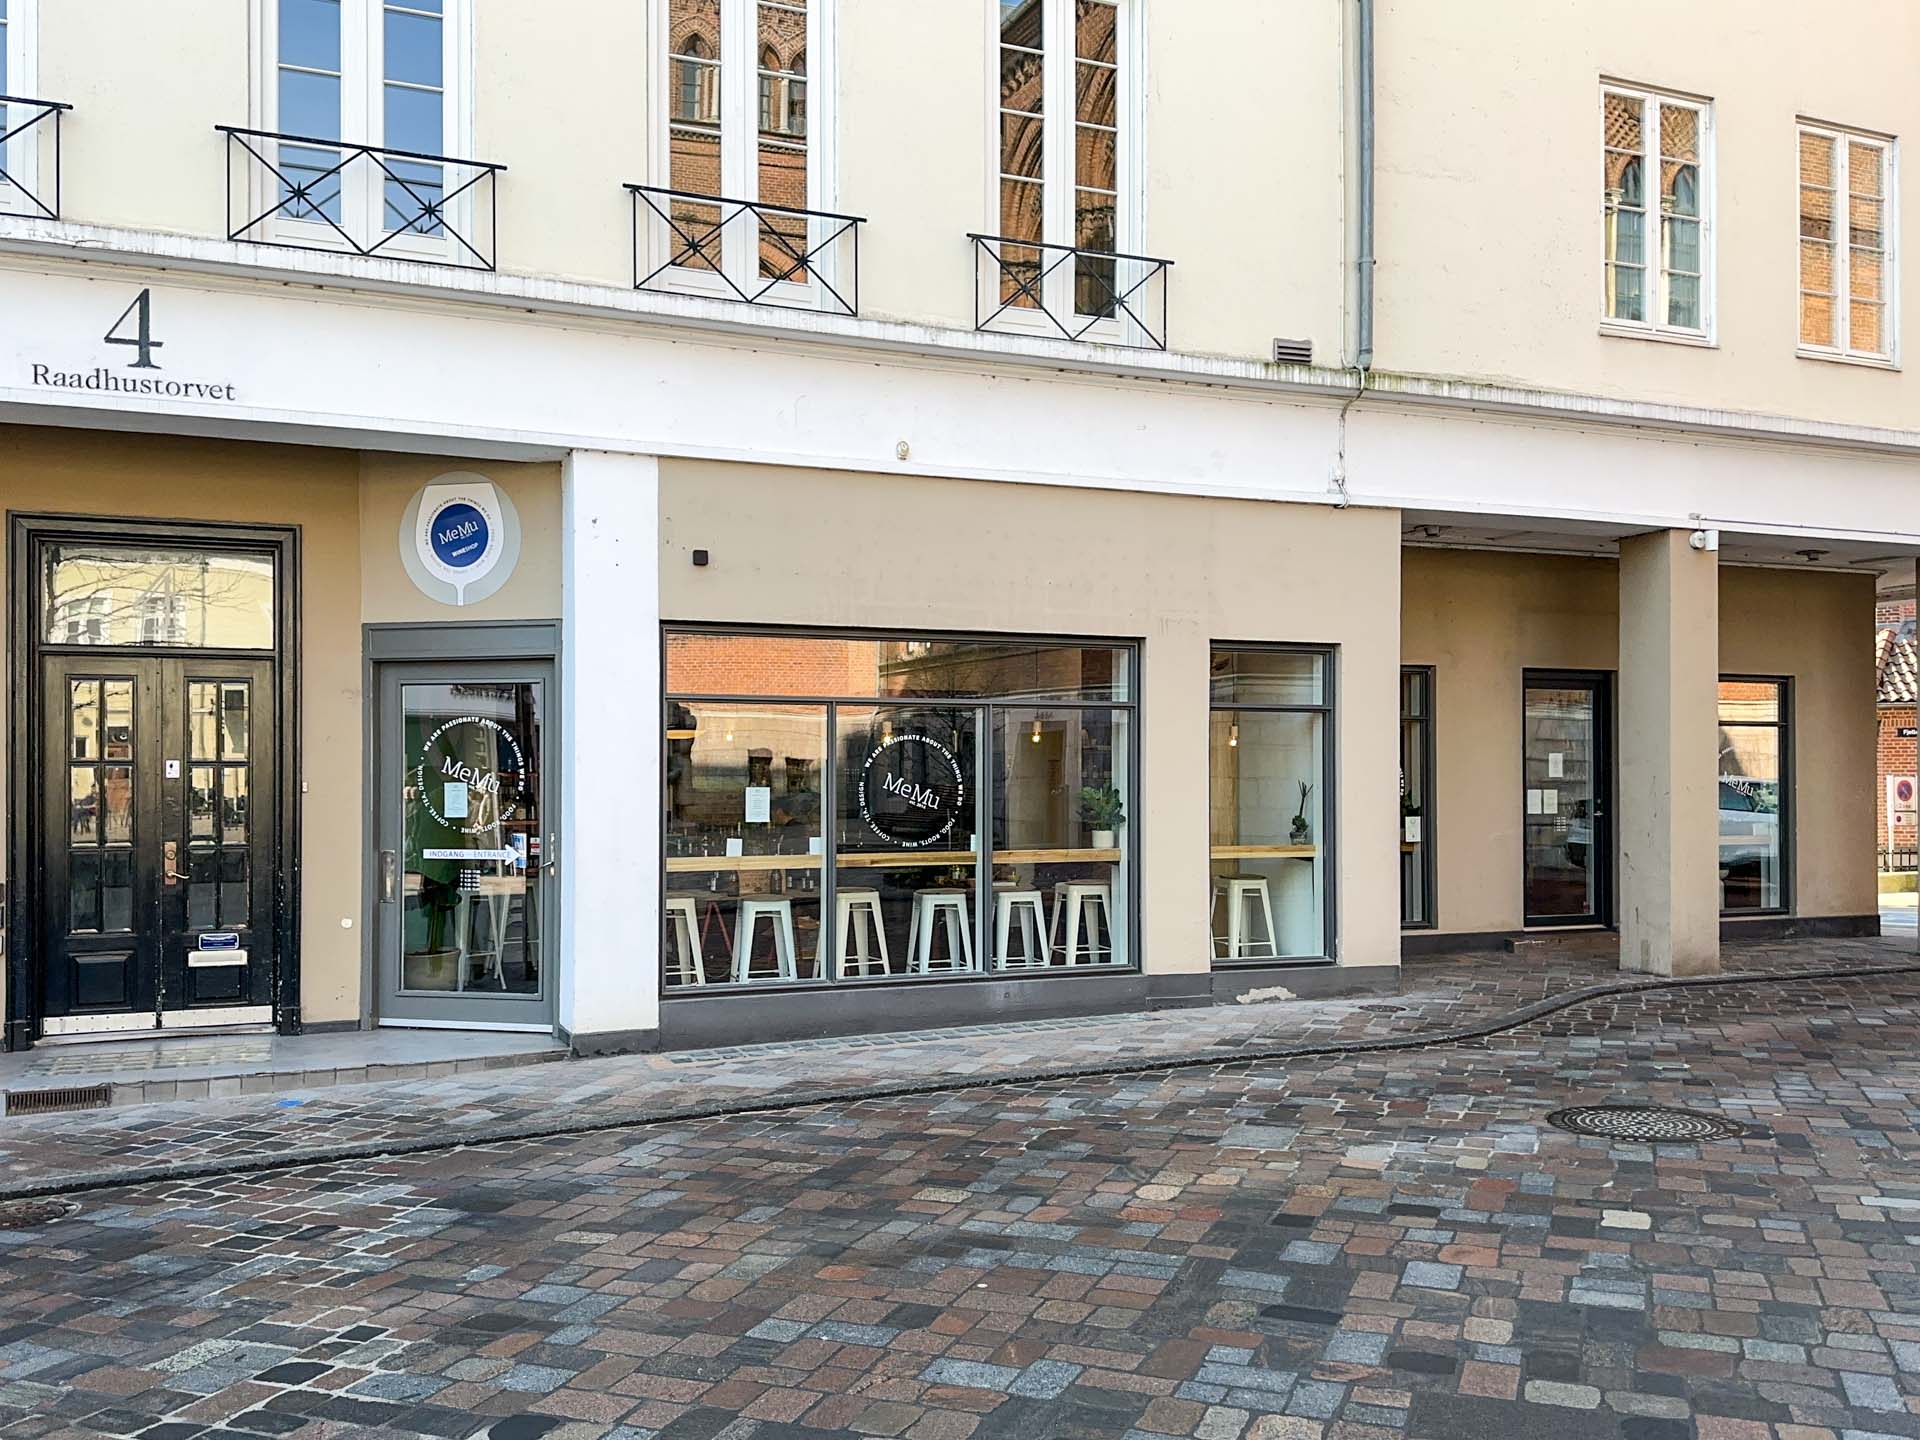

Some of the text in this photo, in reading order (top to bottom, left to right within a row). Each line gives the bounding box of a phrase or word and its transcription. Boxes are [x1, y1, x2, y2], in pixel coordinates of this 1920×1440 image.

[104, 288, 164, 370] 4
[31, 363, 236, 401] Raadhustorvet
[438, 520, 479, 545] MeMu
[441, 716, 480, 732] PASSIONATE
[480, 718, 502, 731] ABOUT
[430, 729, 442, 741] ARE
[502, 729, 513, 742] THE
[883, 734, 920, 748] PASSIONATE
[423, 741, 432, 751] WE
[921, 735, 941, 749] ABOUT
[511, 741, 524, 766] THINGS
[871, 746, 883, 758] ARE
[941, 747, 952, 760] THE
[864, 757, 873, 768] WE
[441, 755, 500, 795] MeMu
[518, 768, 525, 780] WE
[950, 759, 963, 783] THINGS
[517, 780, 525, 792] DO
[957, 784, 964, 795] WE
[1722, 771, 1754, 796] MeMu
[858, 781, 866, 807] DESIGN
[882, 772, 940, 810] MeMu
[956, 796, 963, 806] DO
[429, 850, 511, 859] INDGANG ENTRANCE
